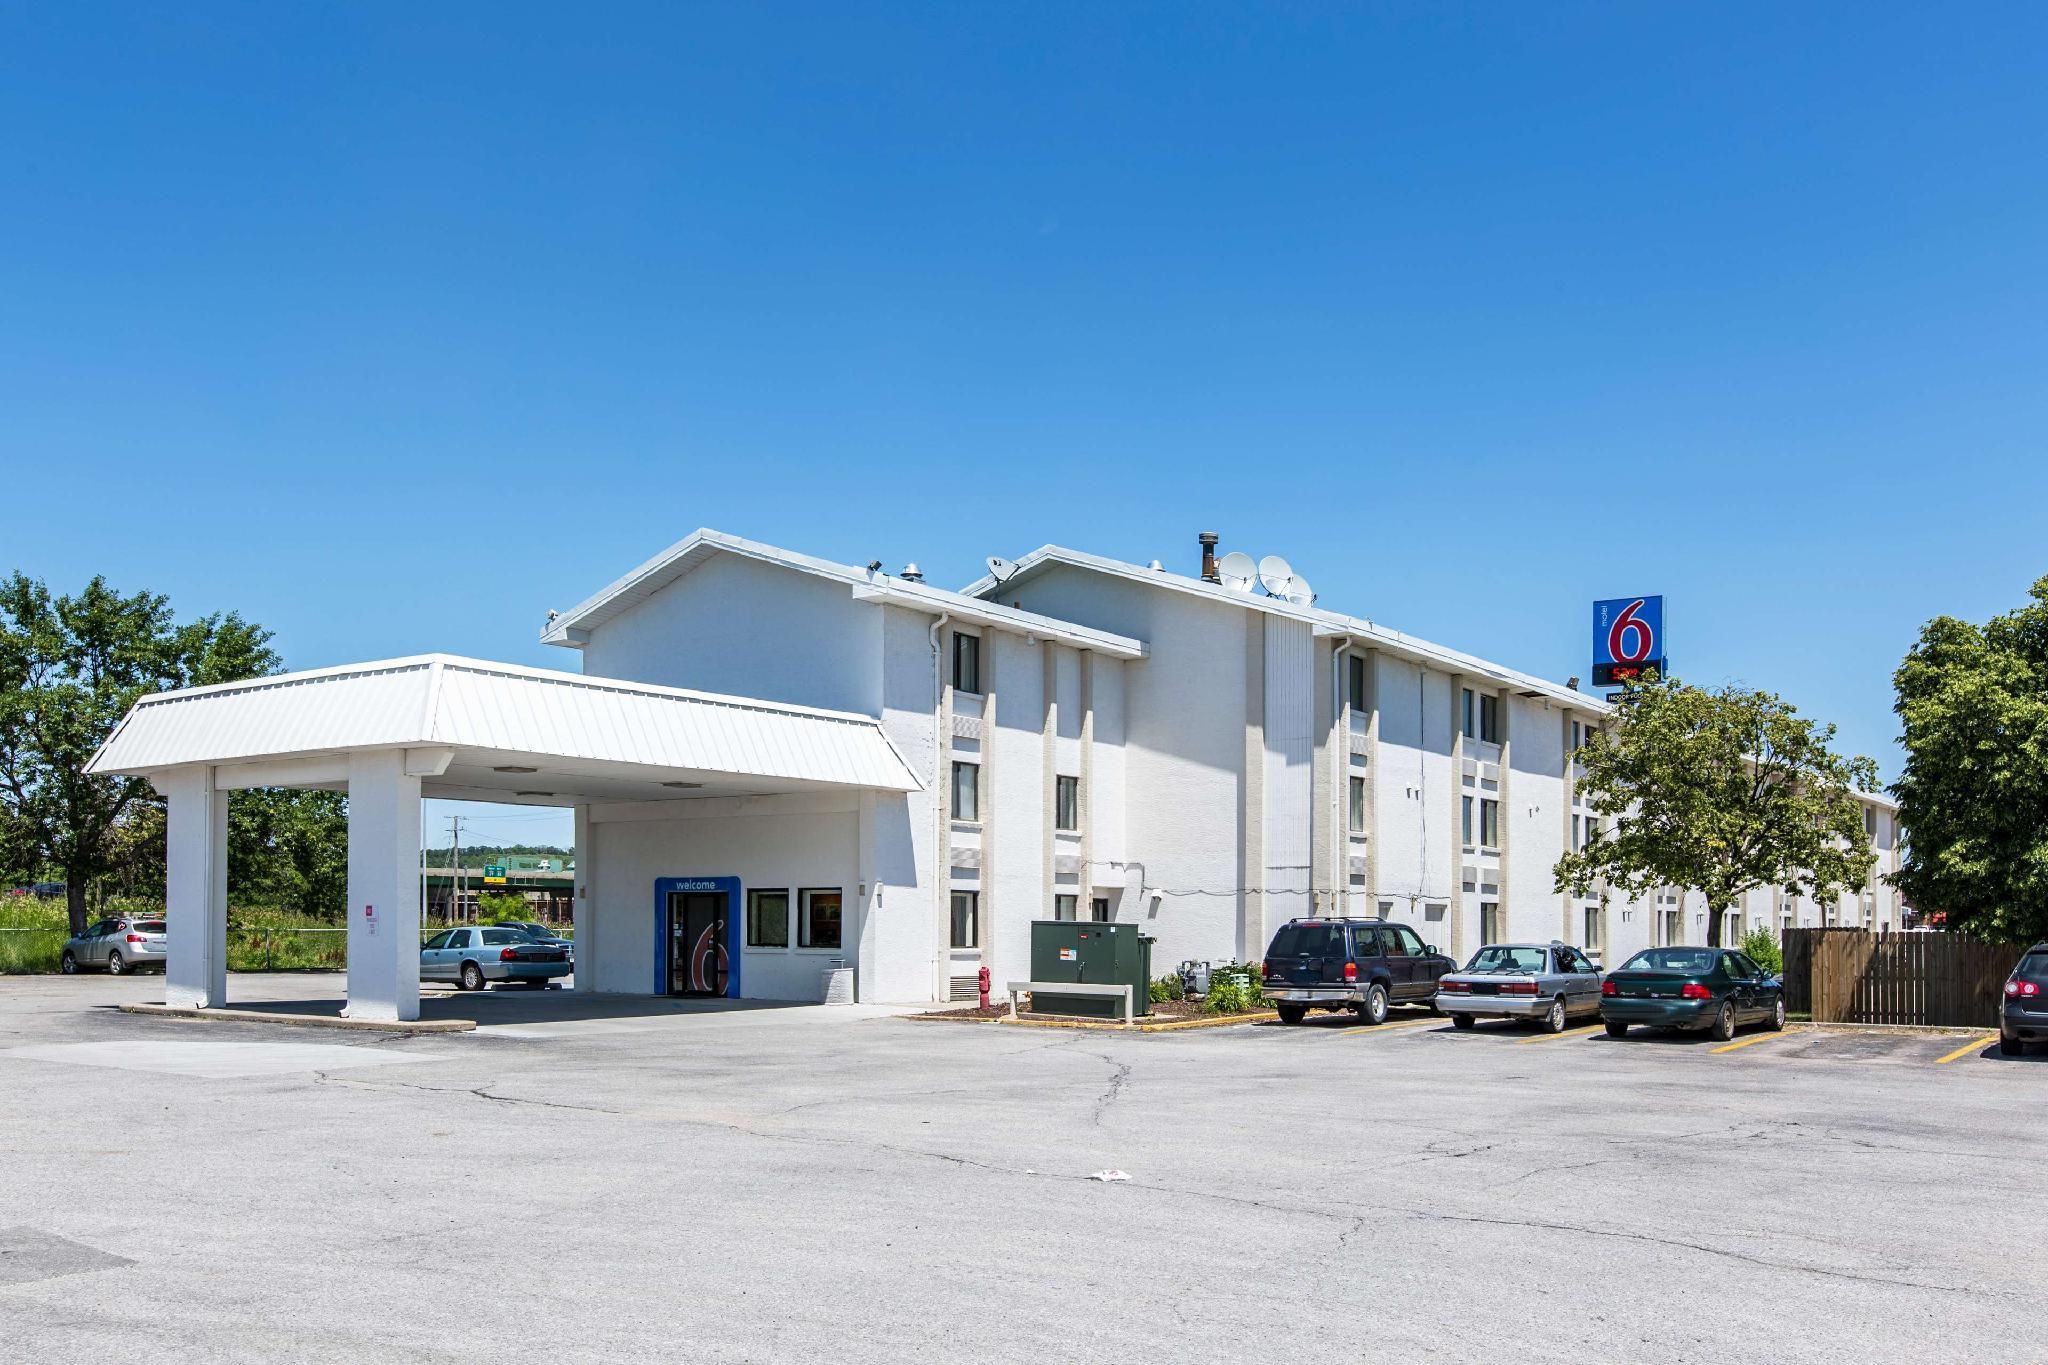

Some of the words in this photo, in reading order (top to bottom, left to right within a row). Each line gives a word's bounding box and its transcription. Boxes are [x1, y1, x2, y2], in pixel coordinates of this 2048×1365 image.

[1608, 599, 1653, 662] 6
[676, 879, 716, 890] welcome
[691, 919, 729, 996] 6
